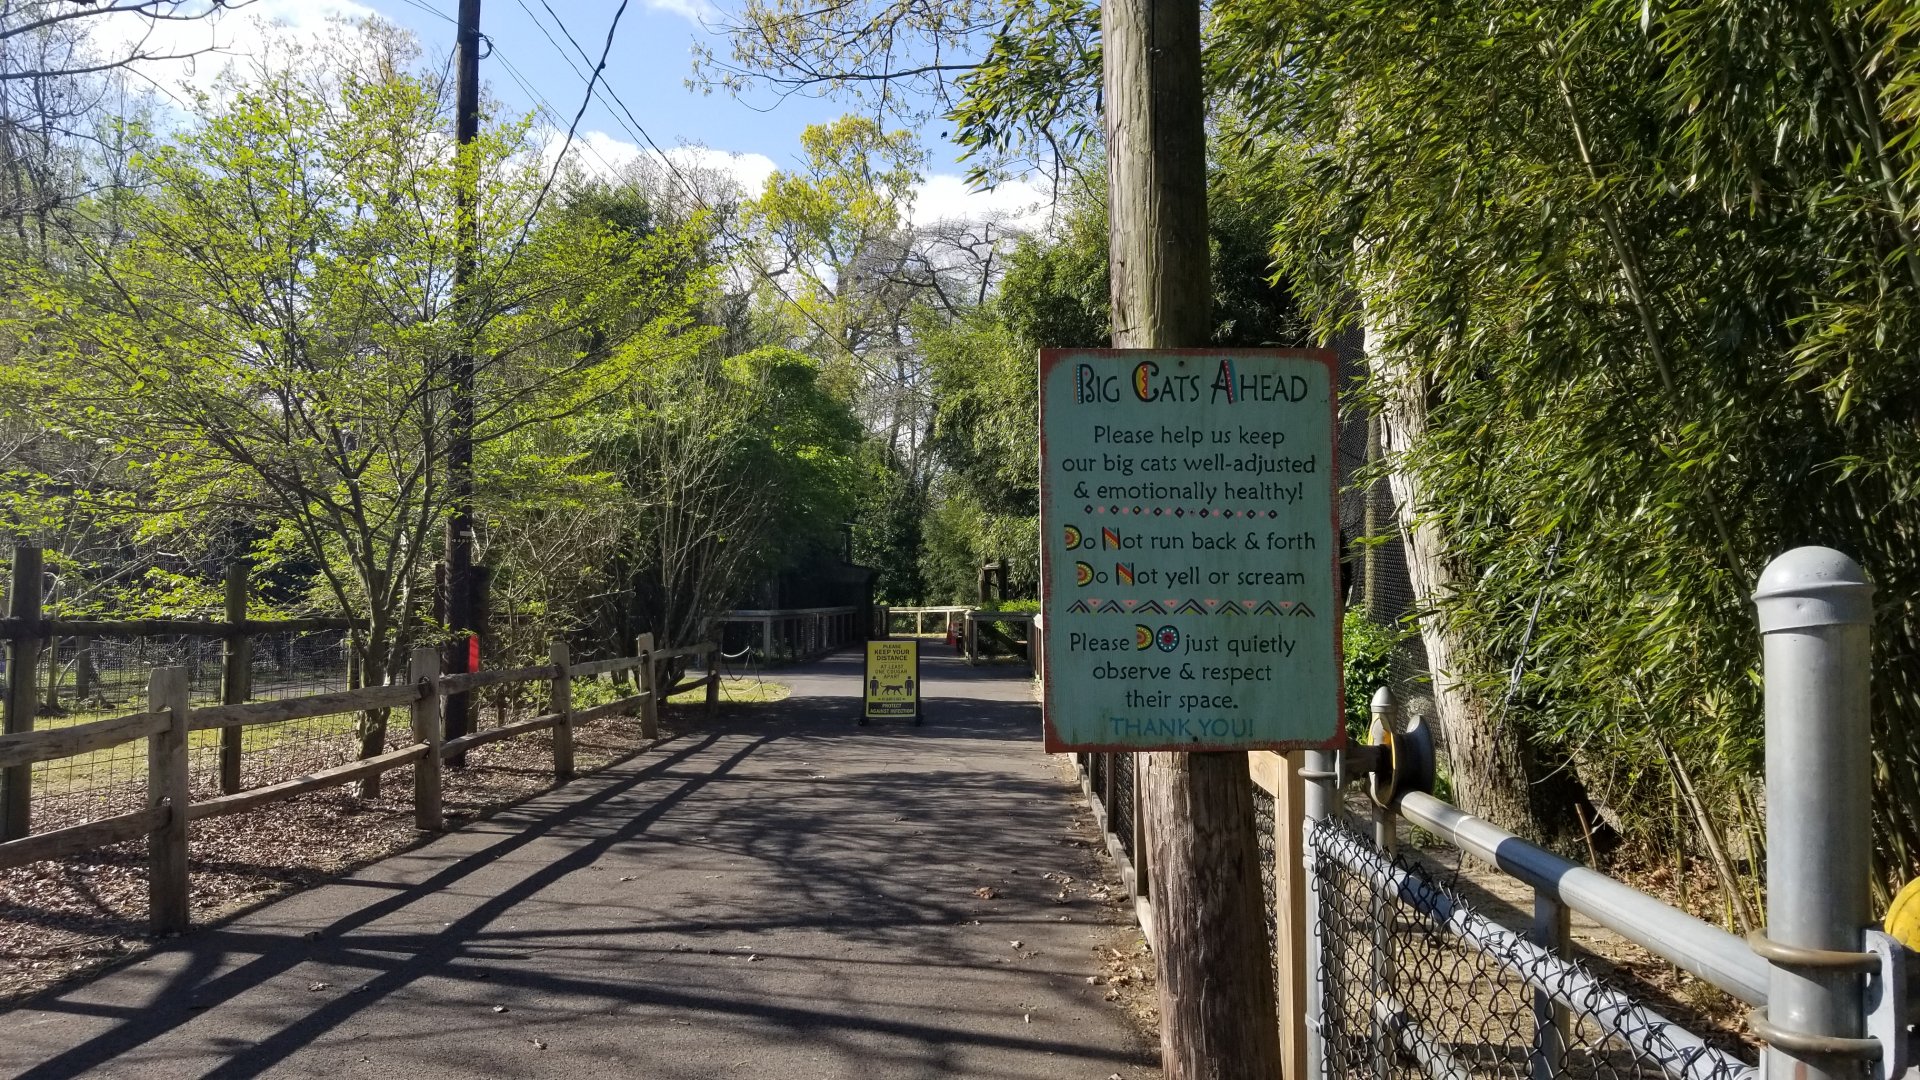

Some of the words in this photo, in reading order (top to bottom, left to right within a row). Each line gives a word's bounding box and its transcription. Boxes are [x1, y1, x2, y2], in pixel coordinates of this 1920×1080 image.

[1073, 363, 1120, 404] BIG
[1132, 360, 1200, 403] CATS
[1211, 359, 1308, 404] AHEAD
[1094, 425, 1154, 444] Please
[1161, 426, 1203, 448] help
[1211, 430, 1231, 444] us
[1239, 426, 1285, 448] keep
[1062, 457, 1096, 472] our
[1103, 454, 1134, 475] big
[1140, 455, 1177, 472] cats
[1183, 454, 1316, 476] well-adjusted
[1073, 481, 1090, 499] &
[1097, 482, 1217, 504] emotionally
[1224, 482, 1303, 504] healthy!
[1064, 524, 1096, 550] Do
[1102, 526, 1143, 550] Not
[1150, 534, 1184, 549] run
[1192, 532, 1236, 550] back
[1244, 532, 1261, 550] &
[1267, 531, 1316, 550] forth
[1075, 561, 1109, 587] Do
[1115, 562, 1159, 587] Not
[1165, 567, 1200, 589] yell
[1208, 570, 1230, 585] or
[1237, 570, 1305, 585] scream
[1069, 632, 1130, 651] Please
[1135, 624, 1180, 653] DO
[1184, 633, 1219, 656] just
[1227, 633, 1297, 657] quietly
[1092, 661, 1171, 680] observe
[1179, 662, 1196, 680] &
[1201, 664, 1272, 686] respect
[1125, 690, 1172, 708] their
[1178, 694, 1239, 713] space.
[1109, 717, 1191, 737] THANK
[1198, 718, 1254, 737] YOU!
